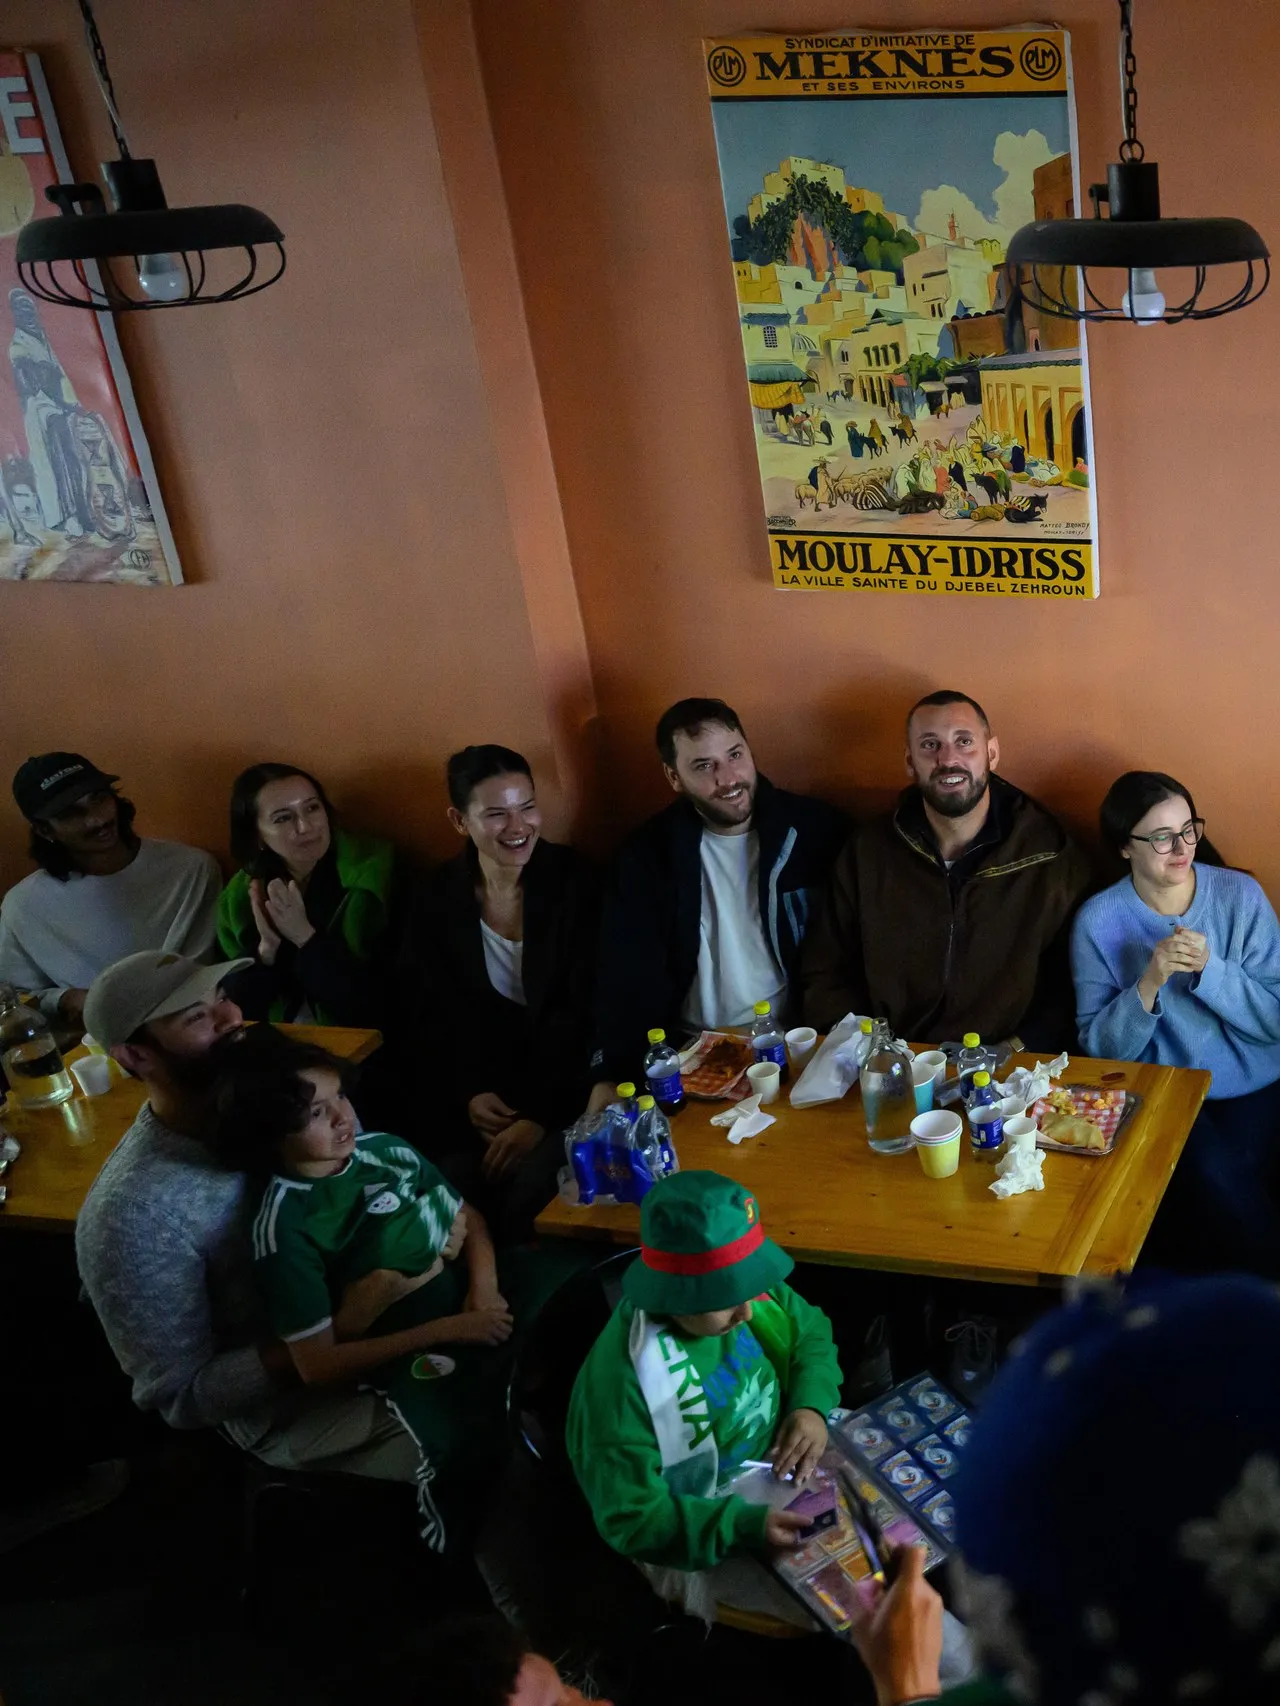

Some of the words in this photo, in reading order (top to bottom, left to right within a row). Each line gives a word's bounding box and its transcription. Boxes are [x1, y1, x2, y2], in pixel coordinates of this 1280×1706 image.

[785, 35, 857, 49] SYNDICAT
[861, 35, 952, 48] D'INITIATIVE
[956, 34, 975, 47] DE
[753, 45, 1015, 80] MEKNÈS
[802, 81, 822, 92] ET
[827, 80, 859, 92] SES
[872, 79, 965, 91] ENVIRONS
[774, 539, 1086, 581] MOULAY-IDRISS
[781, 574, 800, 585] LA
[803, 575, 845, 587] VILLE
[852, 577, 908, 590] SAINTE
[915, 579, 938, 590] DU
[945, 580, 1006, 593] DJEBEL
[1010, 583, 1086, 596] ZEHROUN
